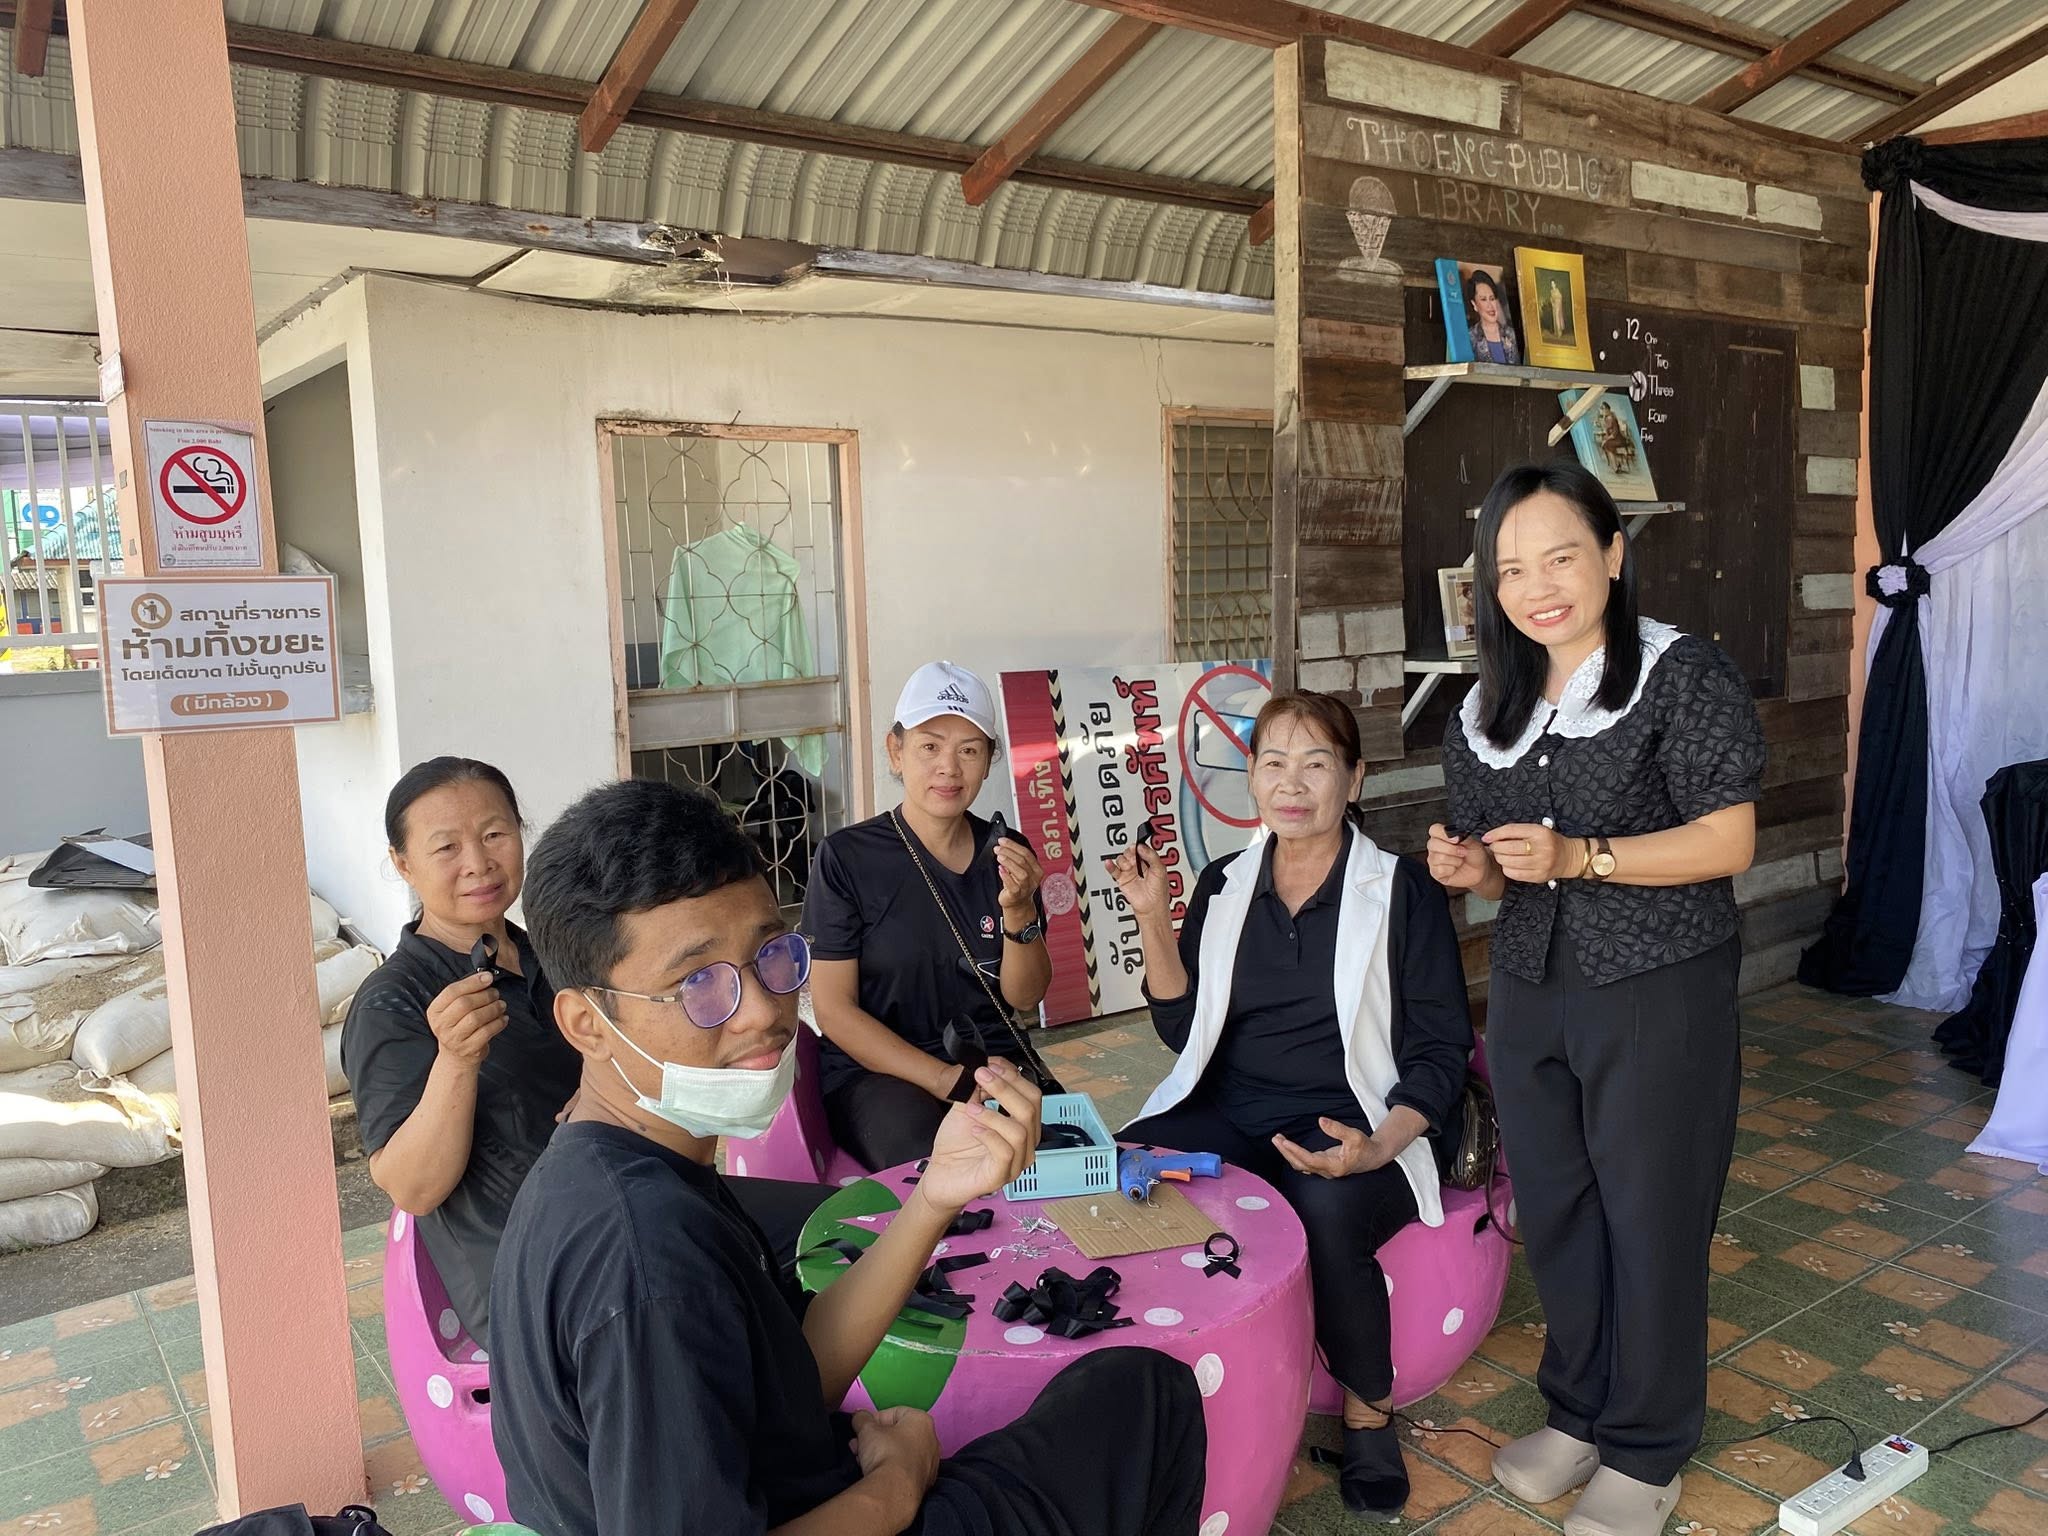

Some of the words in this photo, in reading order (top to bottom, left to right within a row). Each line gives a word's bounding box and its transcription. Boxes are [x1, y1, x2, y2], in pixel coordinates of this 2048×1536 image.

[1346, 117, 1504, 178] THOENG
[1505, 143, 1601, 200] PUBLIC
[1625, 318, 1640, 340] 12
[1654, 353, 1669, 370] Two
[1647, 374, 1674, 398] Three
[1647, 408, 1668, 423] Four
[173, 520, 243, 543] ห้ามสูบบุหรี่
[179, 600, 321, 621] สถานที่ราชการ
[121, 621, 325, 660] ห้ามทิ้งขยะ
[121, 664, 222, 681] โดยเด็ดขาด
[225, 659, 326, 680] ไม่งั้นถูกปรับ
[1028, 761, 1063, 860] สภ.เทิง
